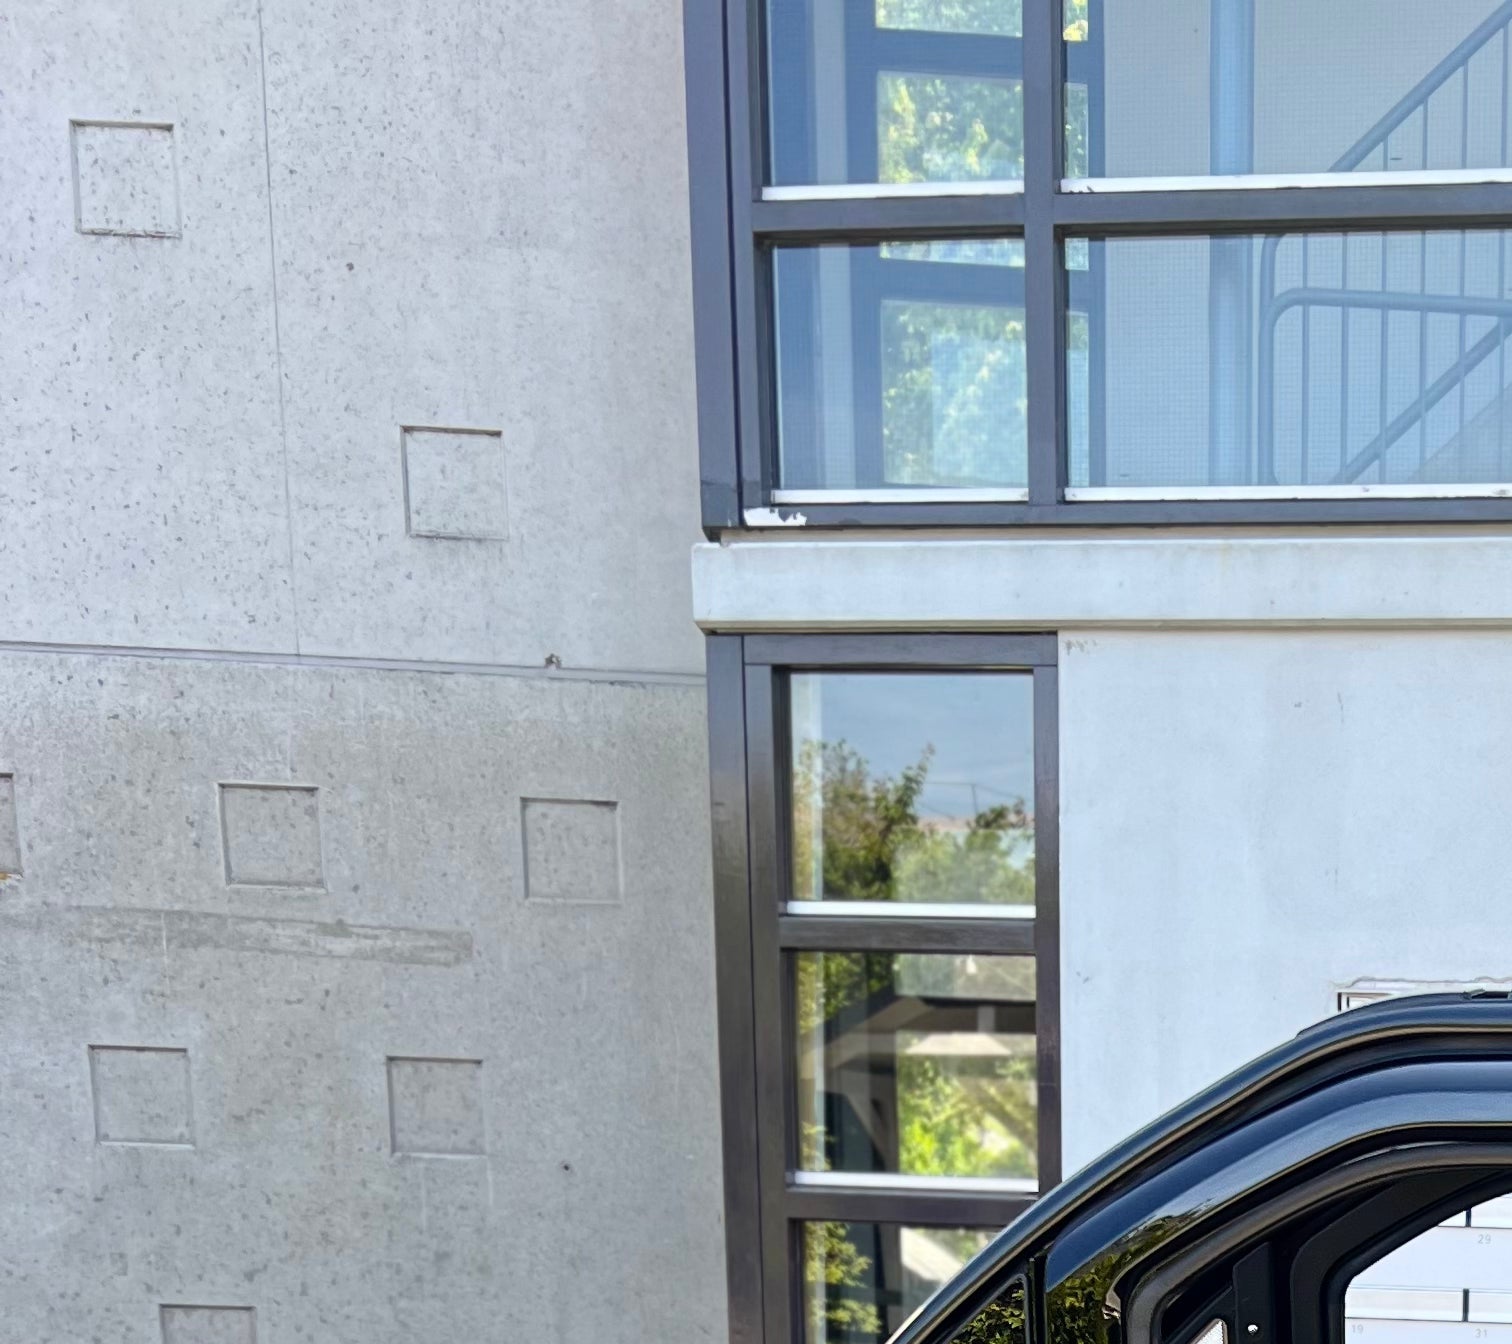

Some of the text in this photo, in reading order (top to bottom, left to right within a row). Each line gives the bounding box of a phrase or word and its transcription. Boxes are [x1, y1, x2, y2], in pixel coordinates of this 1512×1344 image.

[1478, 1234, 1492, 1244] 29
[1352, 1324, 1364, 1335] 19
[1475, 1328, 1488, 1338] 31
